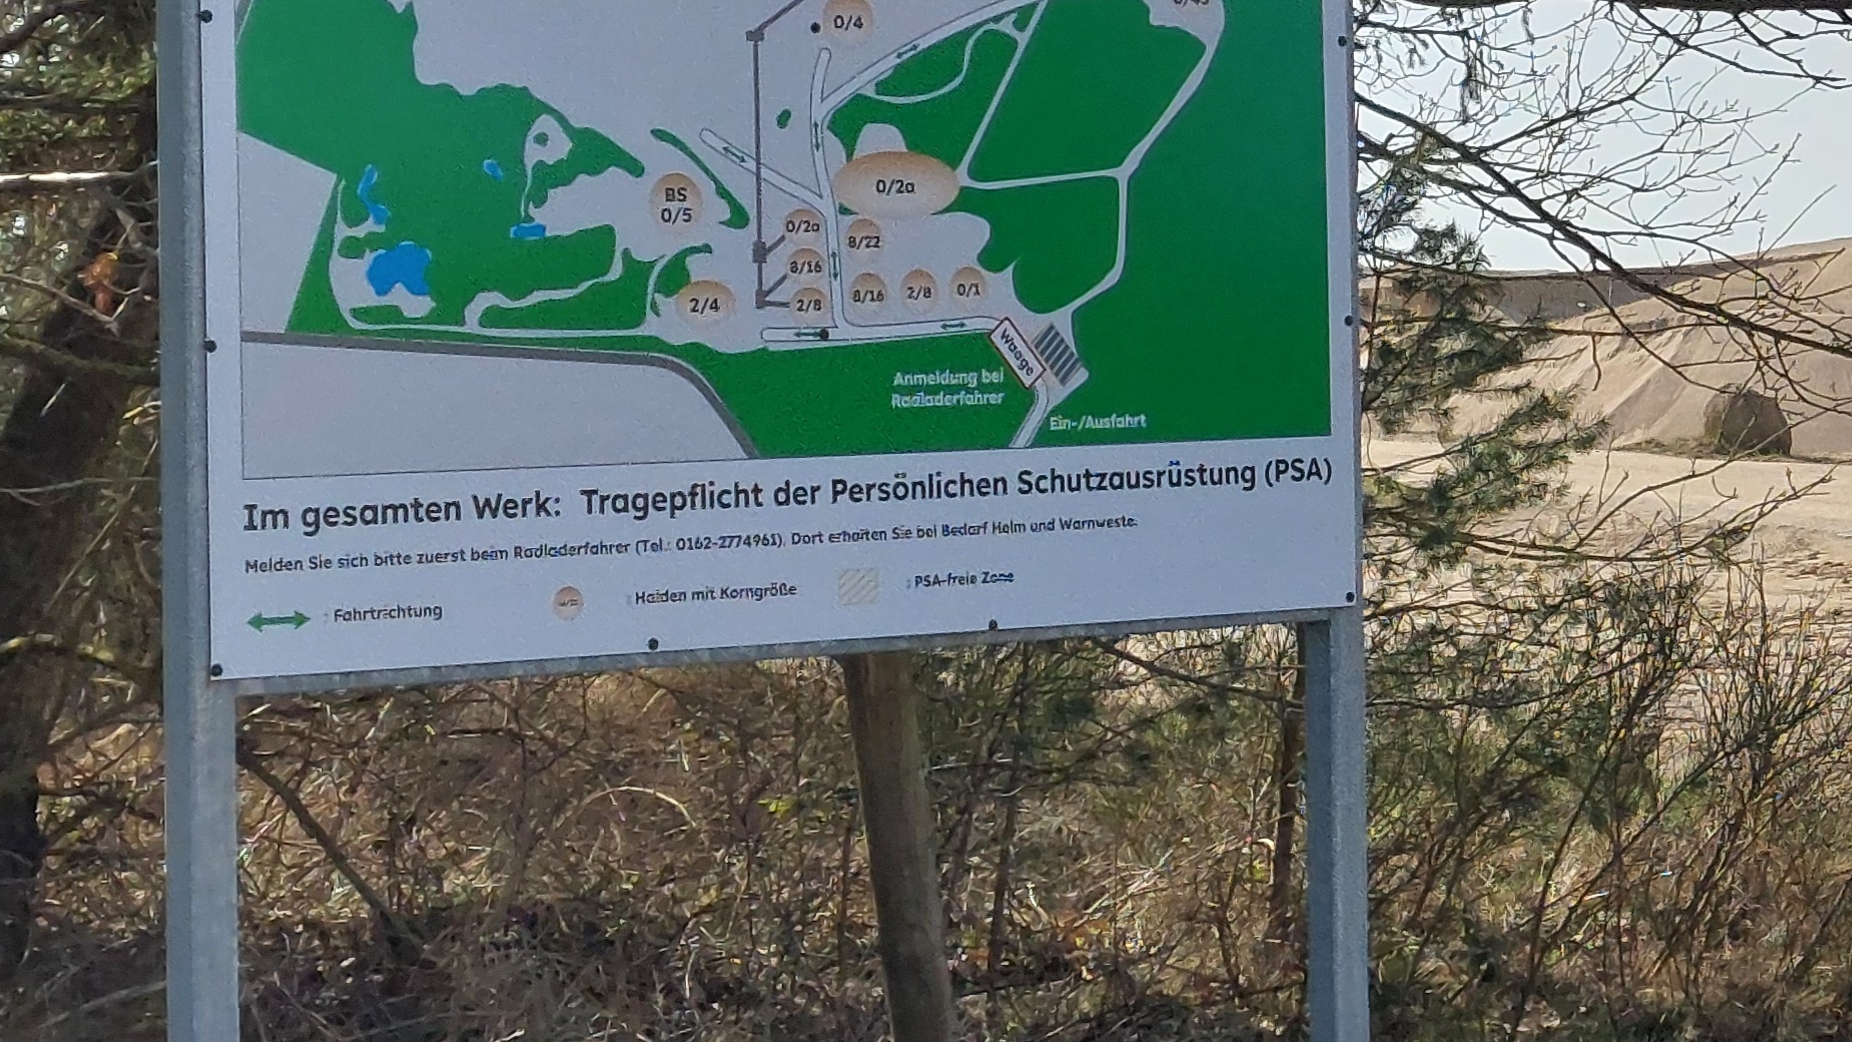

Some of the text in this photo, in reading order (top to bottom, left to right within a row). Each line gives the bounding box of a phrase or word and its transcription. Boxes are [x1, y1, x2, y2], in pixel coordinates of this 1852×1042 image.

[833, 14, 864, 31] 0/4
[665, 187, 687, 202] BS
[875, 179, 915, 195] 0/2a
[660, 207, 692, 223] 0/5
[785, 219, 820, 234] 0/2a
[689, 297, 720, 313] 2/4
[1000, 327, 1034, 377] Waage
[893, 367, 1004, 388] Anmeldung bei
[1050, 413, 1147, 431] Ein-/Ausfahrt
[243, 458, 1332, 536] Im gesamten Werk: Tragepflicht der Persönlichen Schutzausrüstung (PSA)
[245, 557, 303, 573] Melden
[308, 555, 332, 569] Sie
[337, 552, 368, 568] sich
[374, 551, 411, 566] bitte
[417, 548, 466, 564] zuerst
[471, 546, 508, 561] beim
[513, 541, 630, 558] Radladerfahrer
[791, 531, 824, 545] Dort
[828, 528, 887, 543] erhalten
[892, 526, 913, 540] Sie
[917, 525, 937, 538] bei
[942, 522, 988, 537] Bedarf
[992, 520, 1026, 535] Helm
[1030, 518, 1055, 532] und
[915, 571, 1015, 588] PSA-freie Zone
[691, 586, 715, 601] mit
[720, 583, 797, 602] Korngröße
[334, 605, 442, 623] Fahrtrichtung
